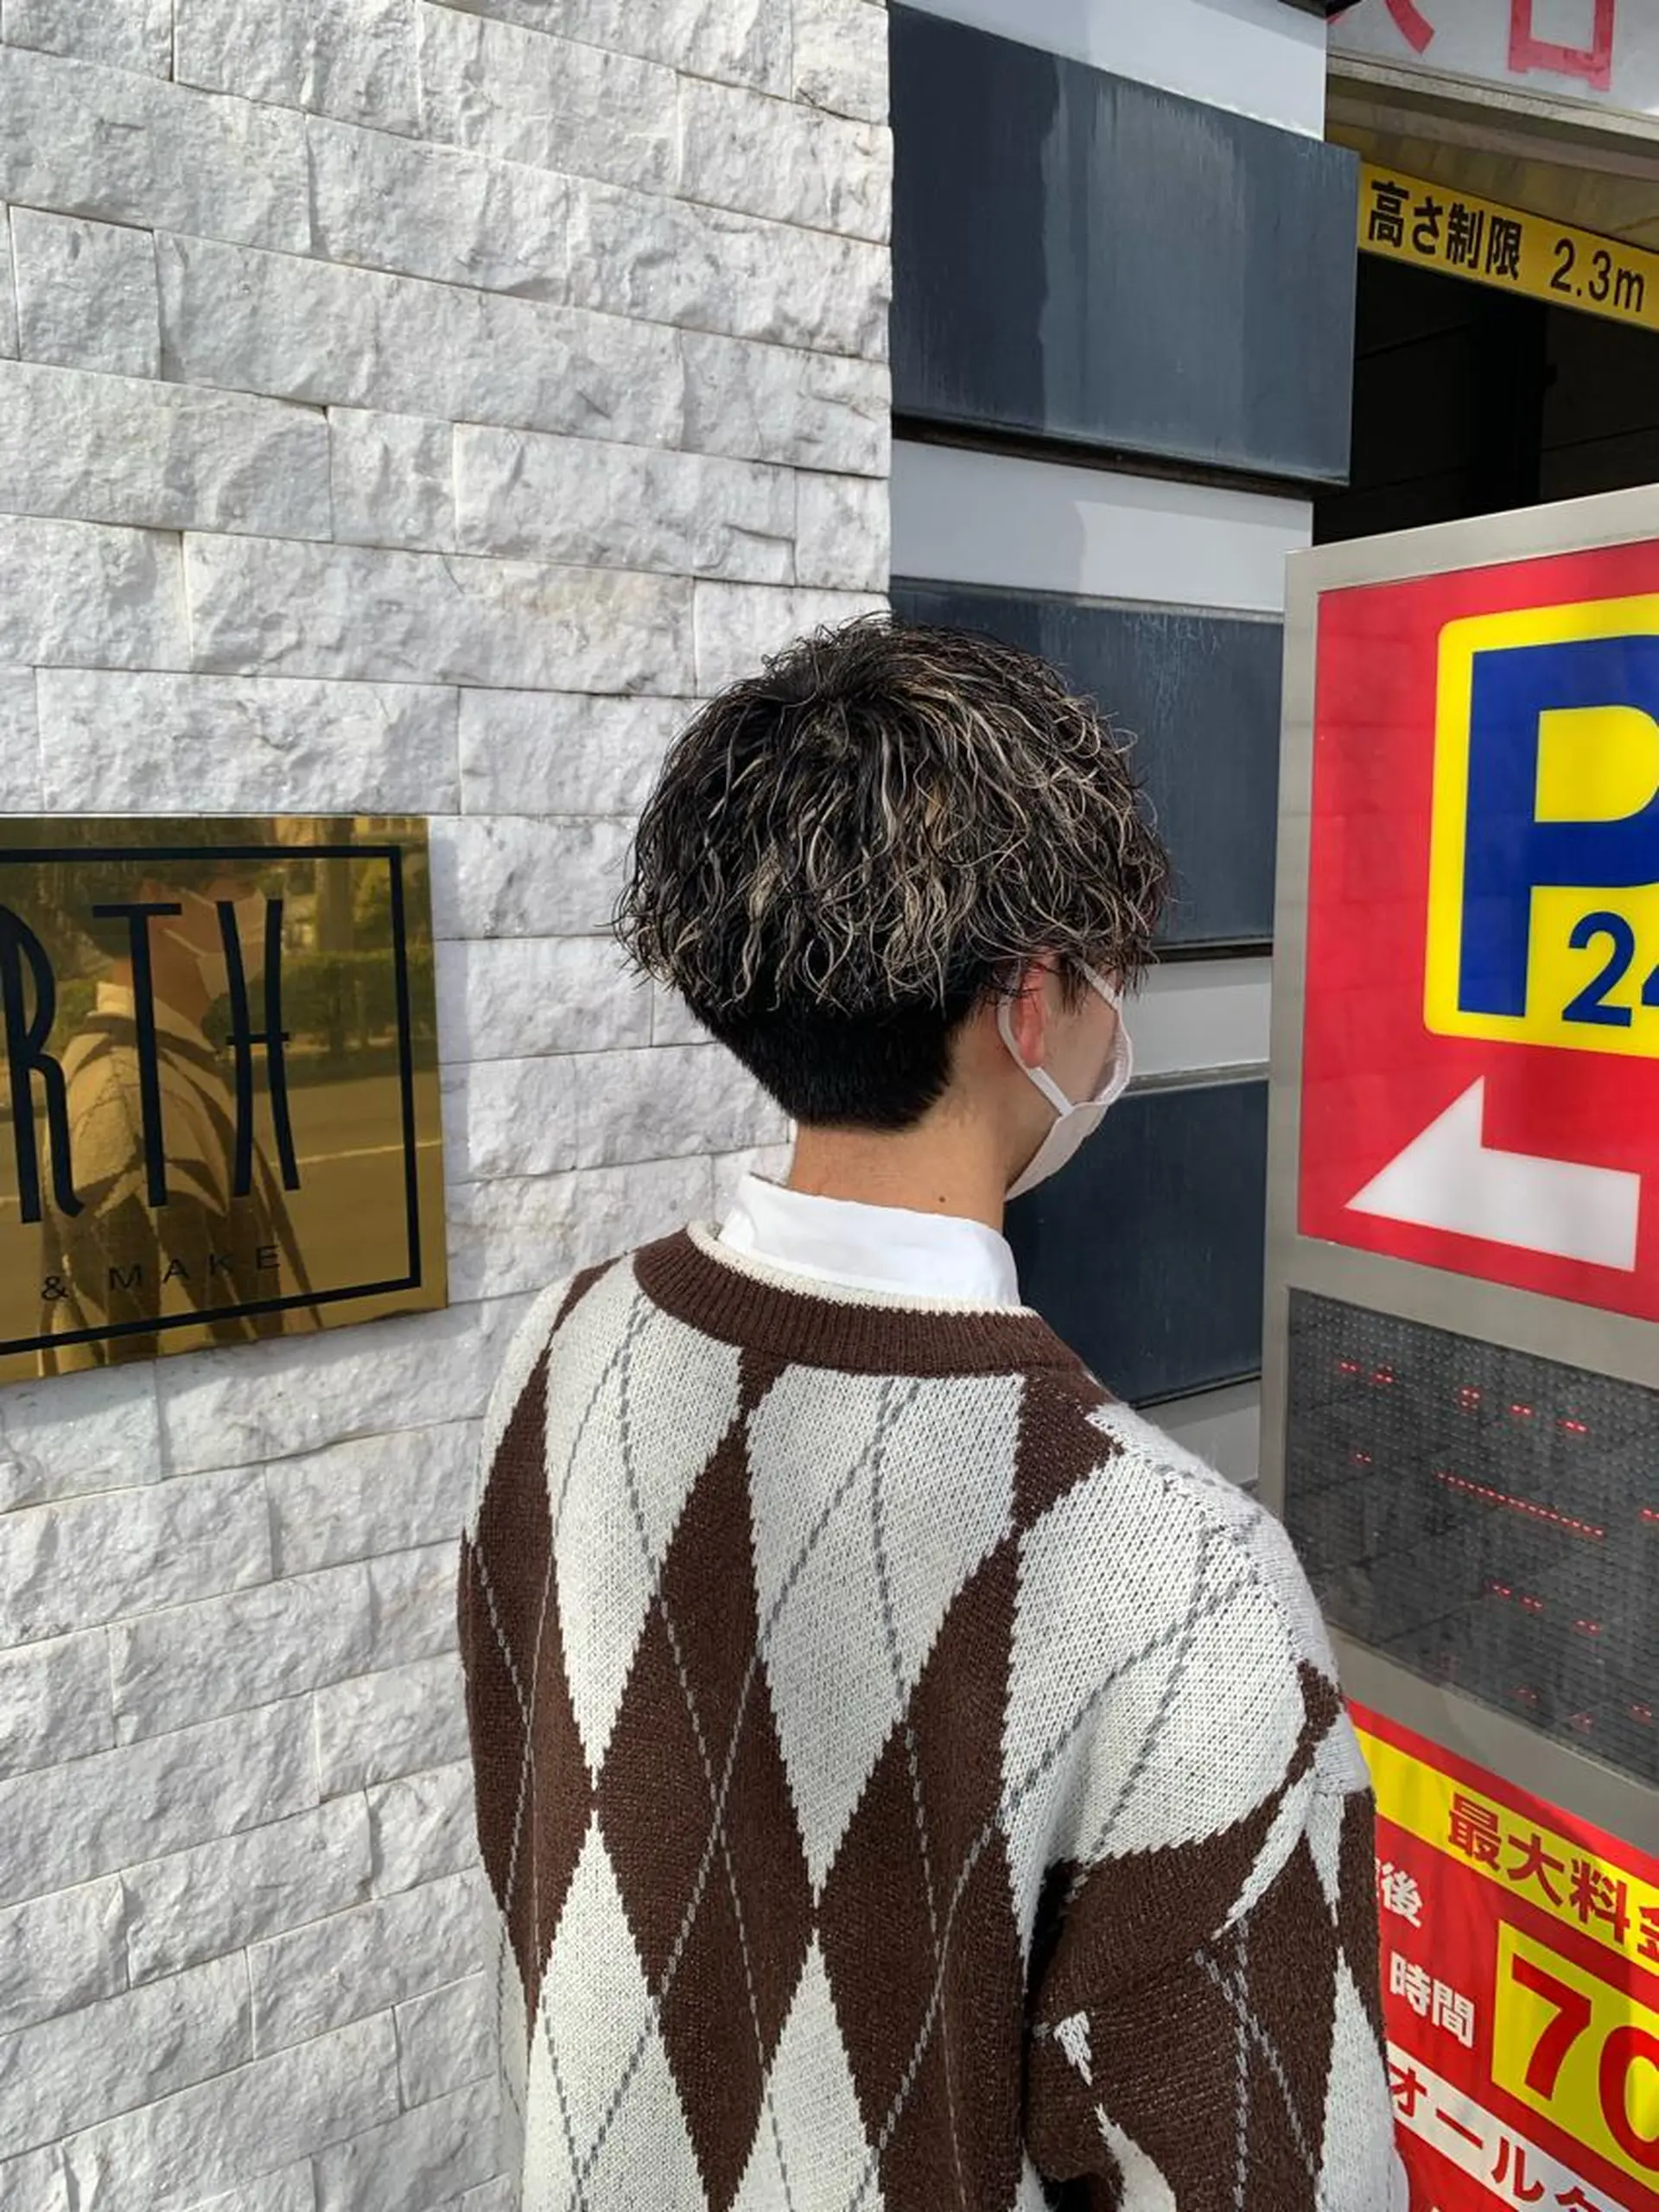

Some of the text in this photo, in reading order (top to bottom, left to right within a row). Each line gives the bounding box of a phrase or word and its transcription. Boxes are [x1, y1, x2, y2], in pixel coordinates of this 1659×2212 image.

[1328, 0, 1615, 92] 口
[1367, 181, 1645, 313] 高さ制限 2.3m
[1458, 634, 1659, 1018] P
[1561, 911, 1659, 1028] 2
[41, 1245, 281, 1301] & MAKE
[1389, 1949, 1475, 2050] 時間
[1388, 2062, 1604, 2212] オール
